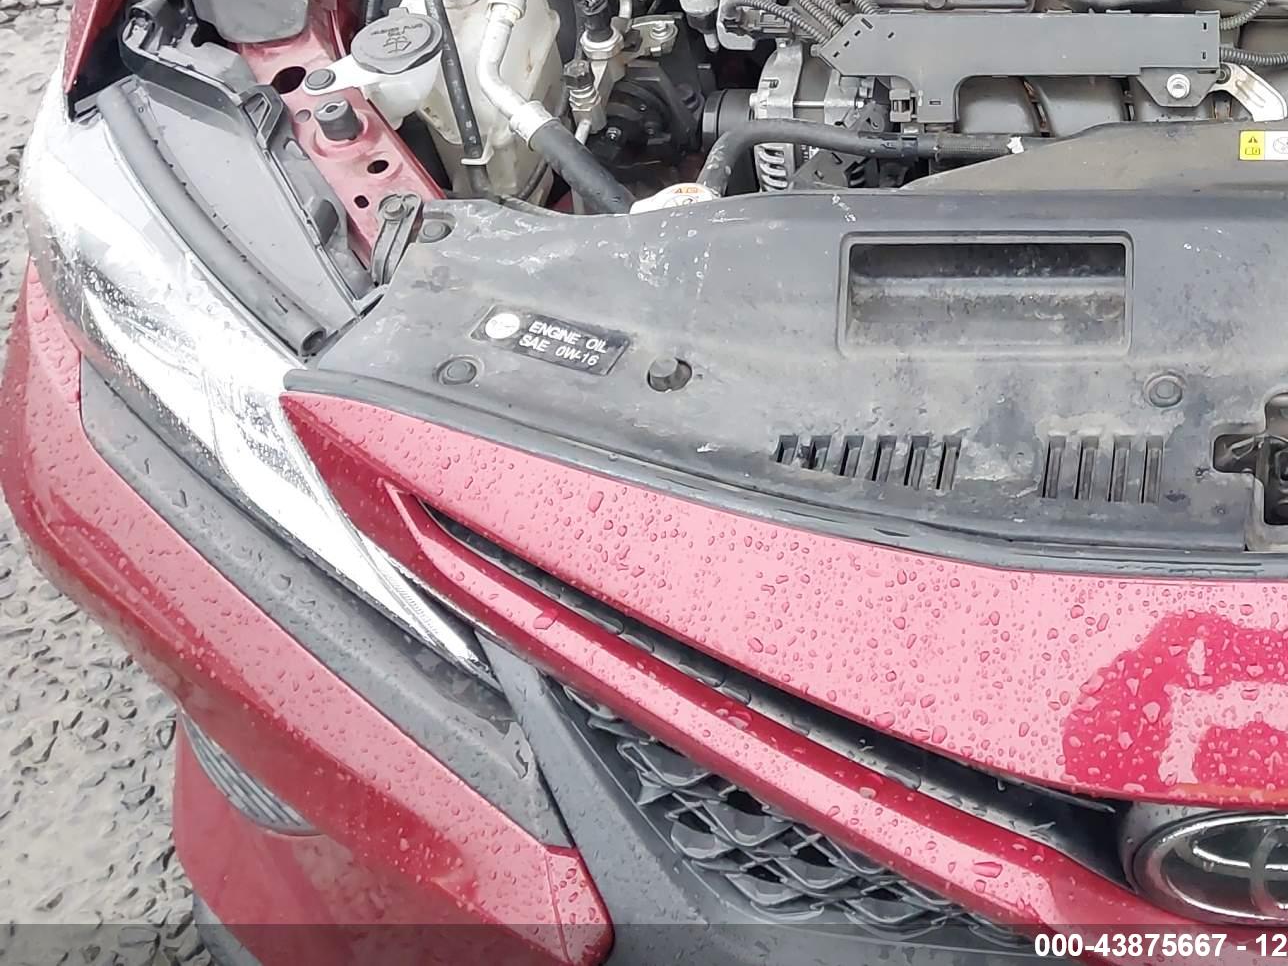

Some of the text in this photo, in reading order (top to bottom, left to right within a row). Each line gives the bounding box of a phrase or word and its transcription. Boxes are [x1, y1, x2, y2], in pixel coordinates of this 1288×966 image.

[519, 334, 600, 366] SAE 0W-16
[528, 320, 582, 345] ENGINE
[585, 338, 607, 354] OIL
